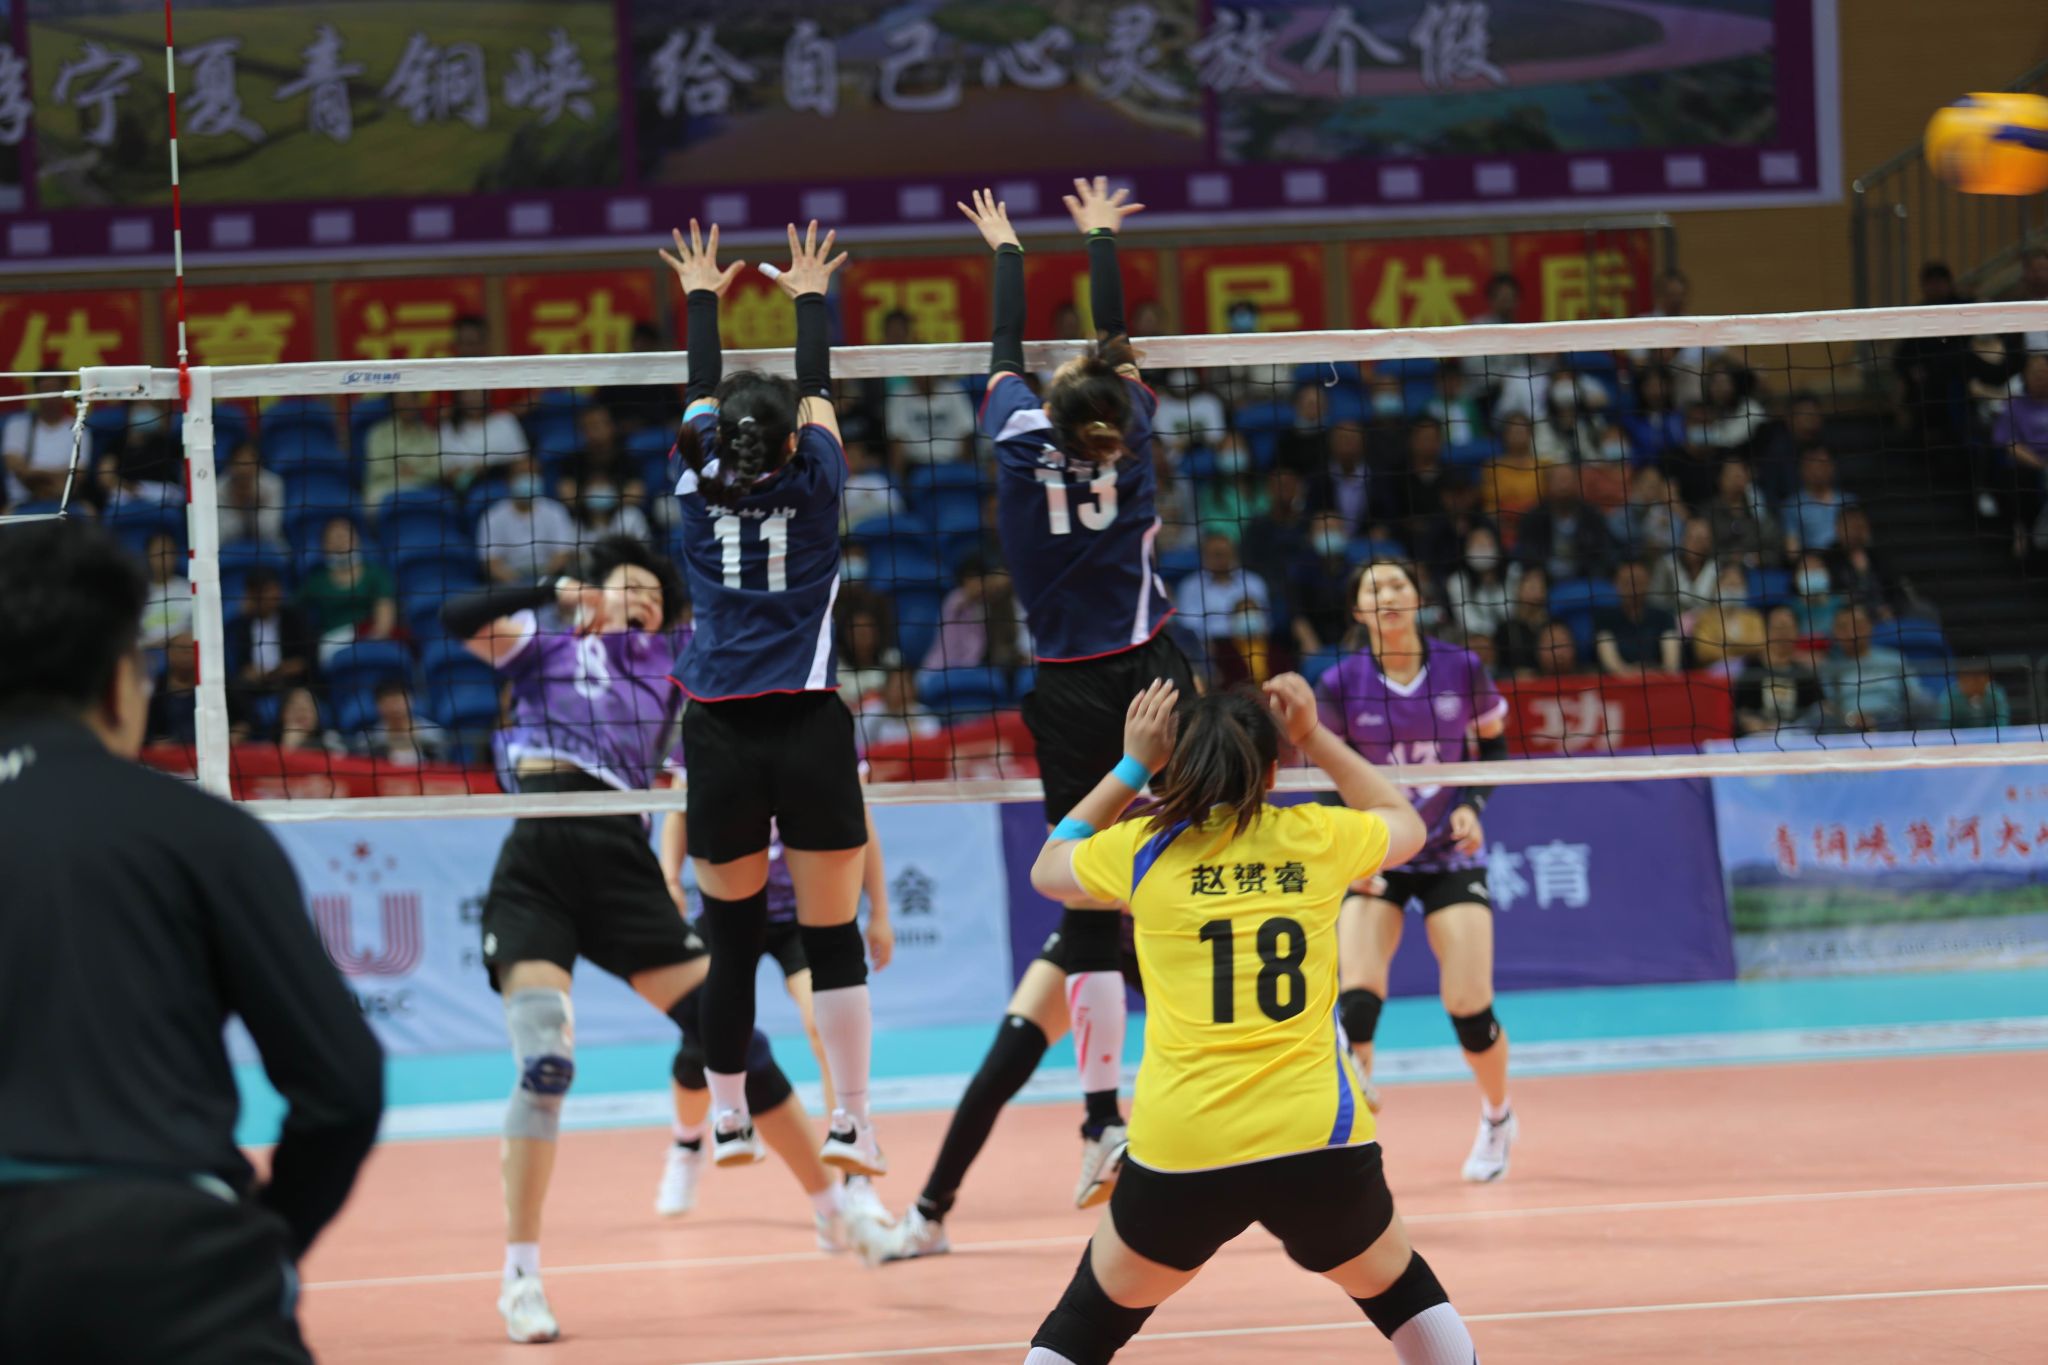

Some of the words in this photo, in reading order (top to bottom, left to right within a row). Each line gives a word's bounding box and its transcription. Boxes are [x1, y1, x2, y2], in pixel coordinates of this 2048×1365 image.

[649, 2, 1506, 117] 给自己心灵放个假
[1034, 465, 1119, 535] 13
[713, 514, 789, 592] 11
[1191, 861, 1309, 895] 赵赟睿
[1199, 916, 1306, 1023] 18
